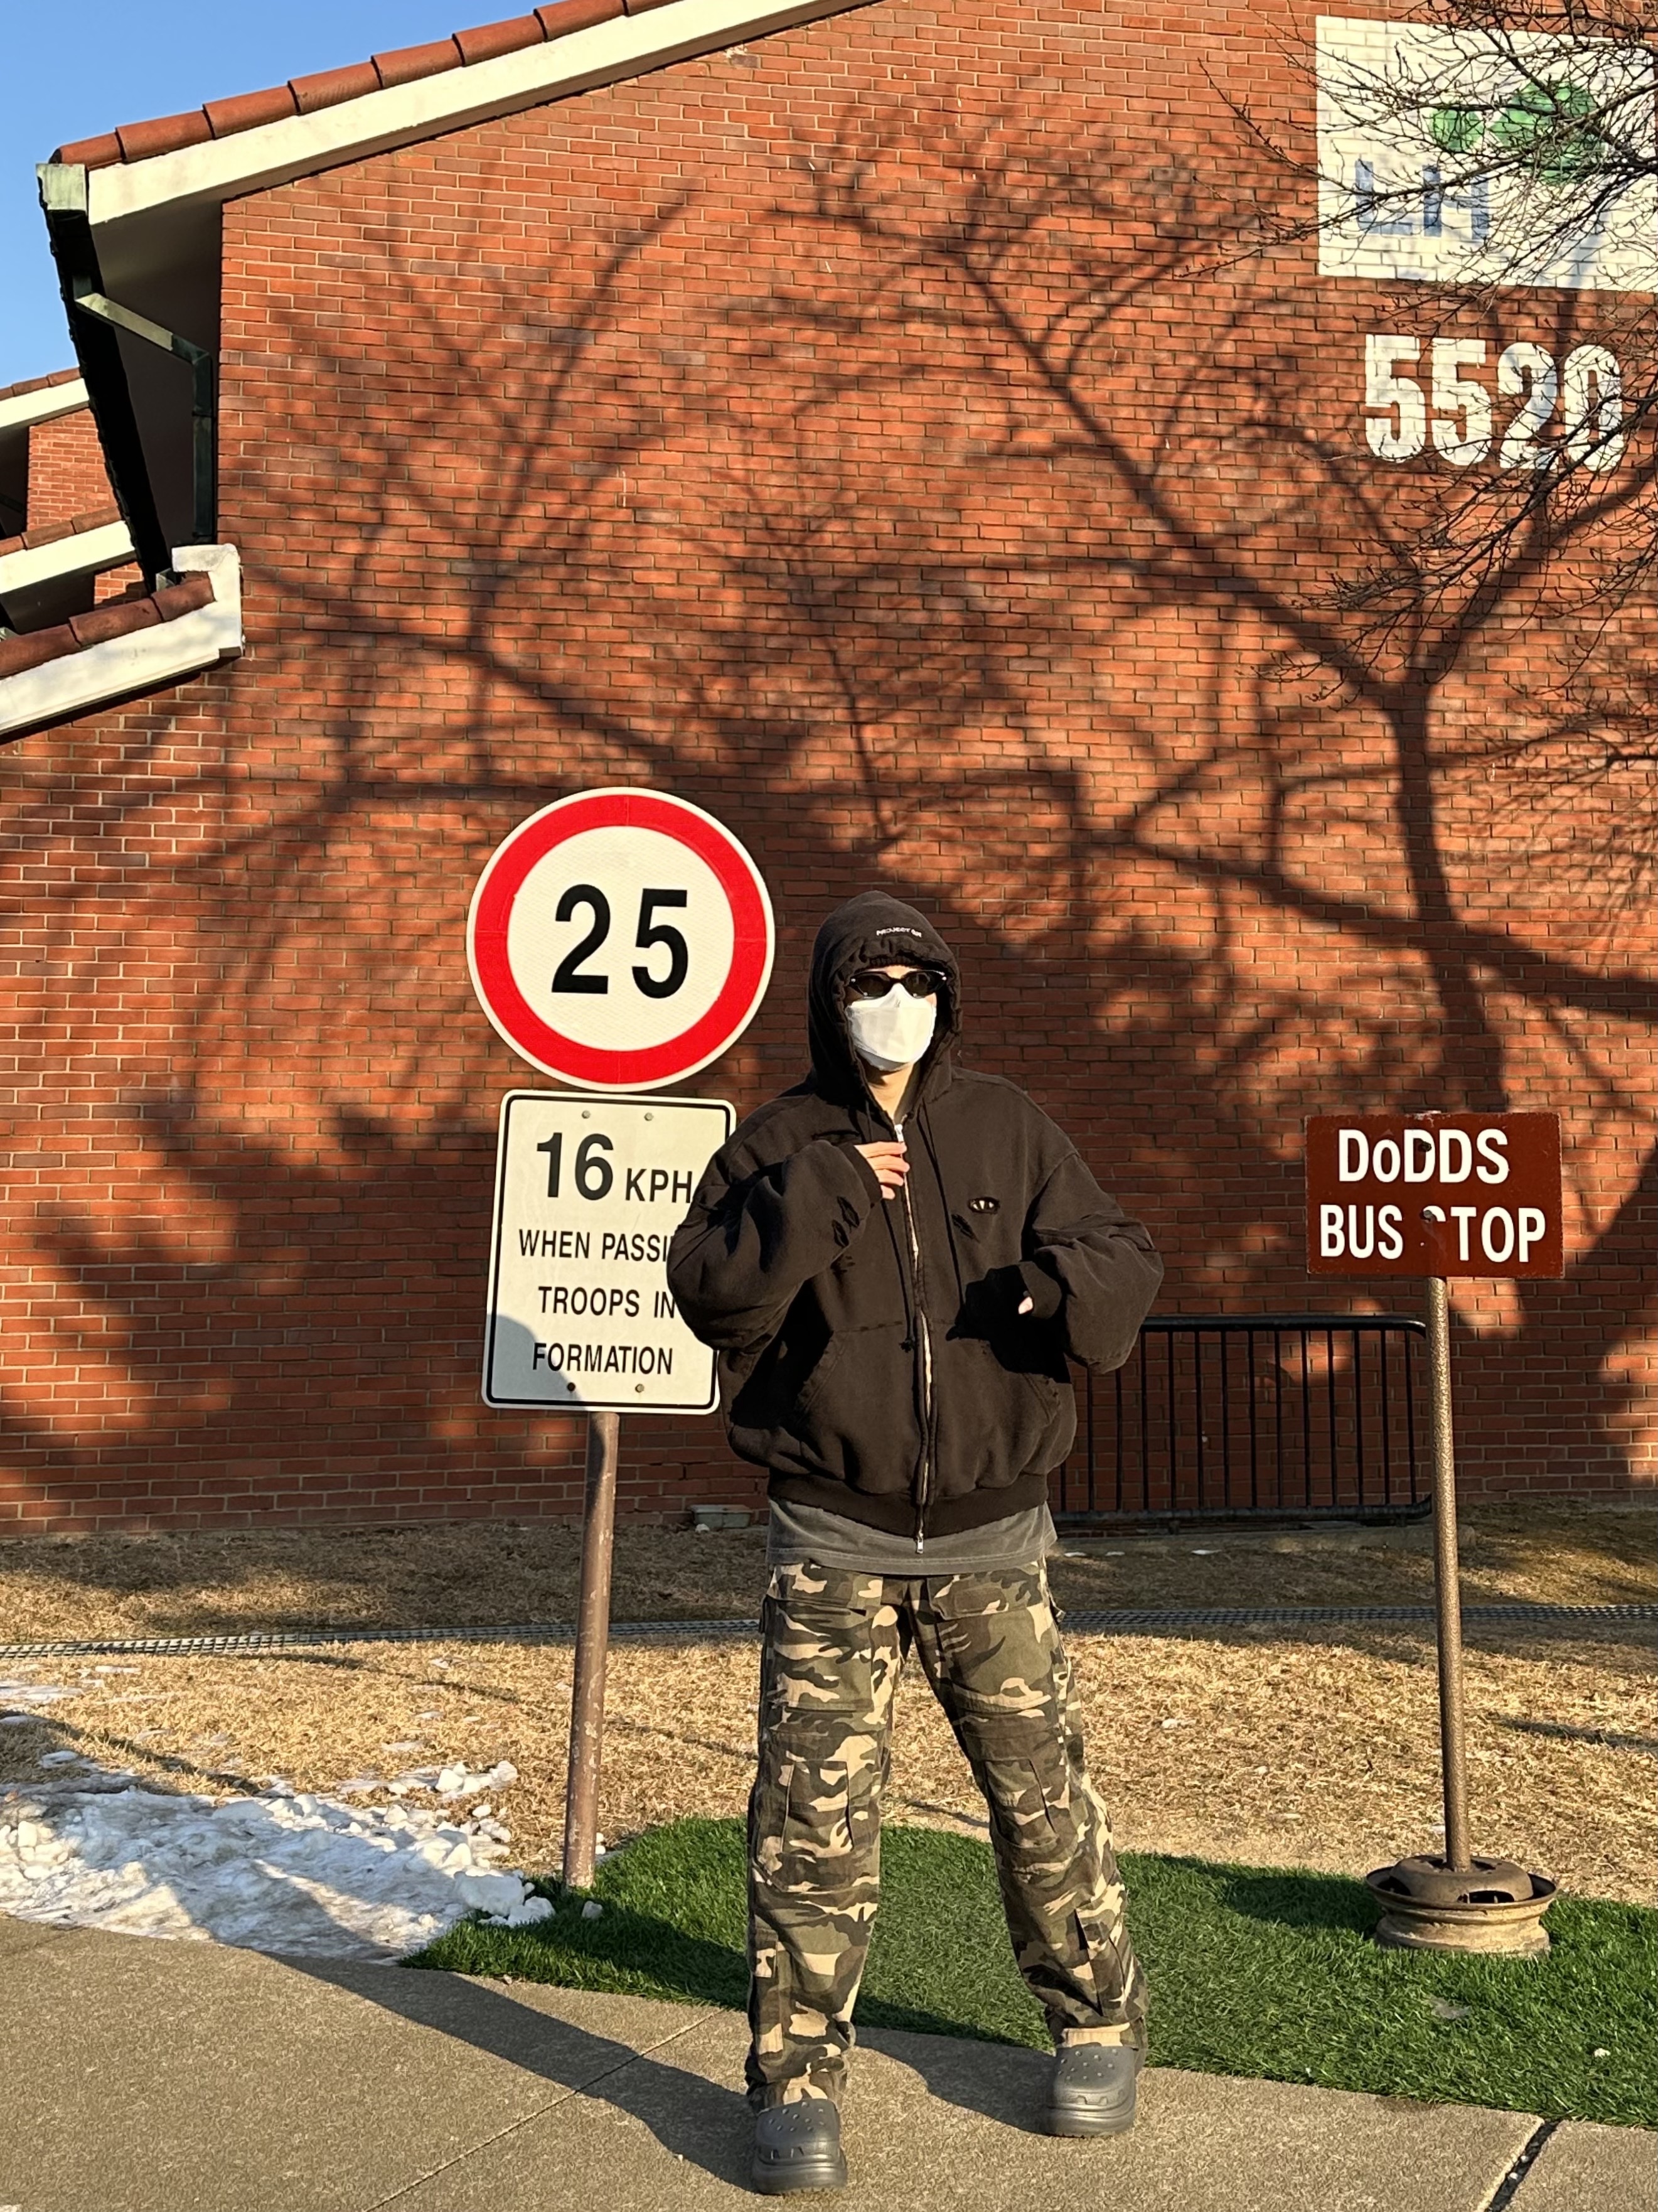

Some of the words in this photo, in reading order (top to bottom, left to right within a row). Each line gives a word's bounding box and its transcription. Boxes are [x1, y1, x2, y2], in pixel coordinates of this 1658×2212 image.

[1365, 333, 1623, 472] 5520
[551, 884, 688, 999] 25
[537, 1132, 614, 1201] 16
[624, 1168, 693, 1203] KPH
[1339, 1129, 1510, 1184] DoDDS
[519, 1228, 591, 1259] WHEN
[601, 1232, 674, 1262] PASSI
[1320, 1204, 1403, 1260] BUS
[538, 1286, 640, 1318] TROOPS
[654, 1291, 676, 1319] IN
[532, 1342, 673, 1375] FORMATION
